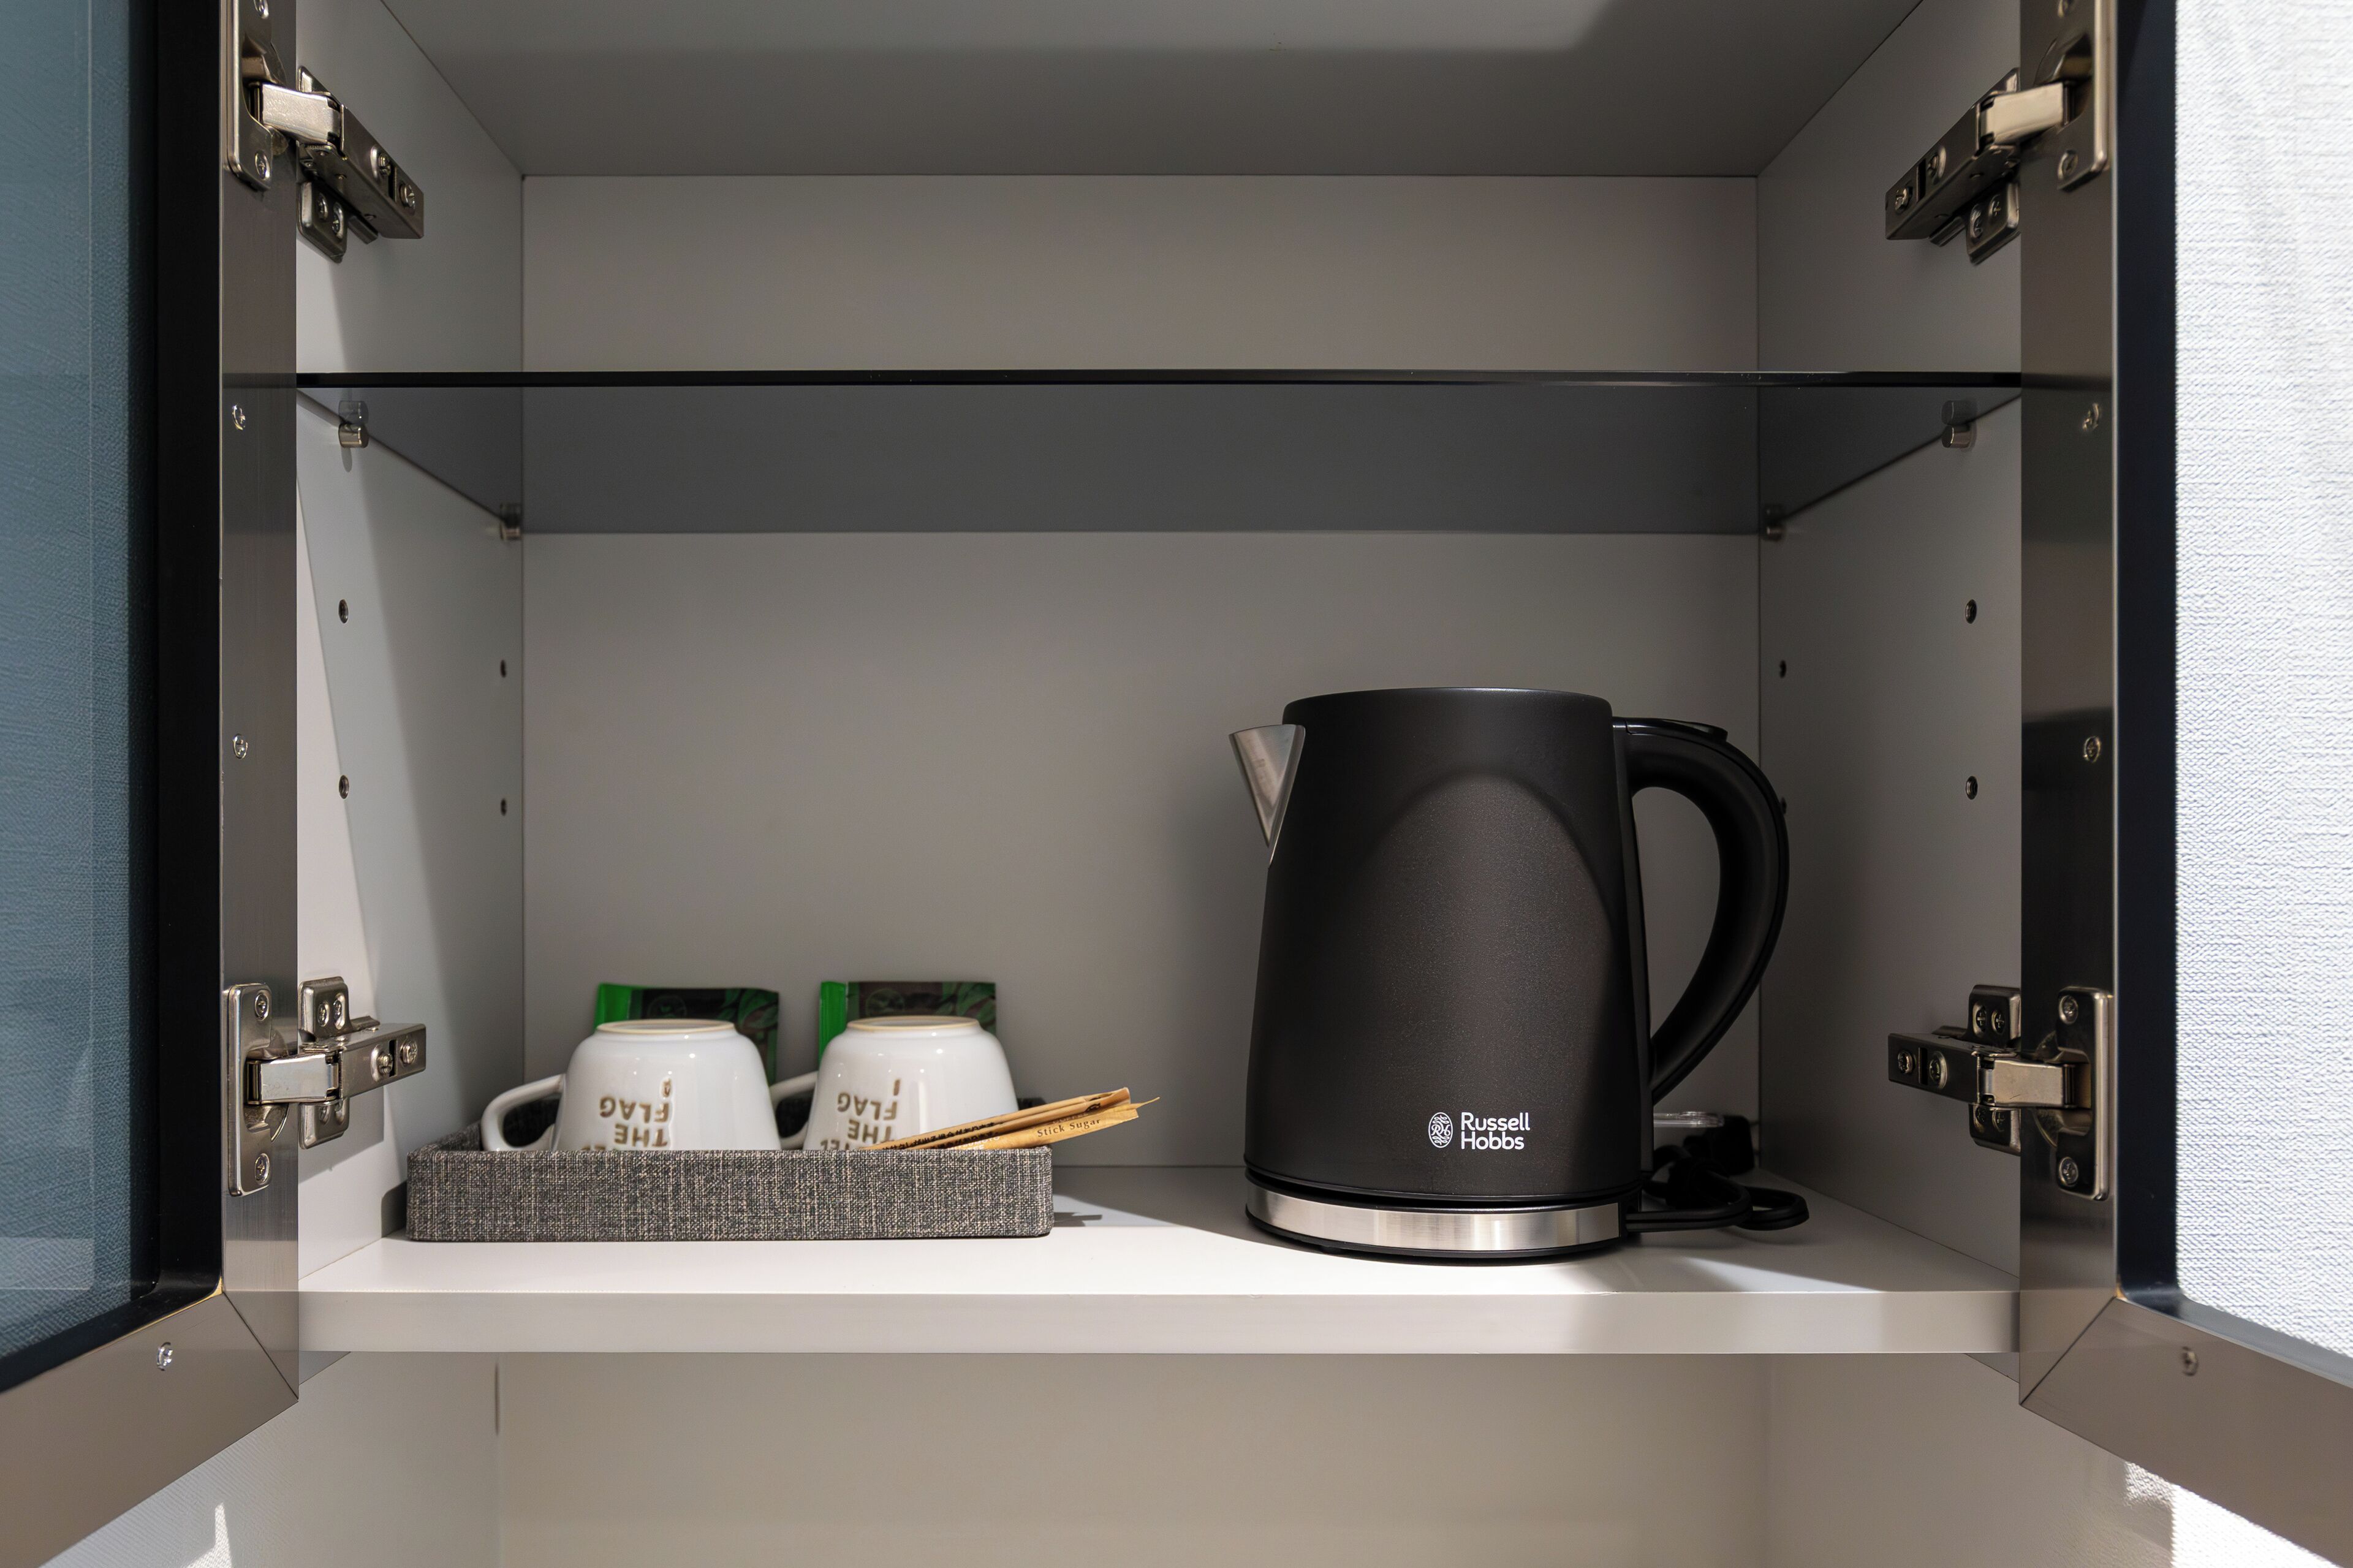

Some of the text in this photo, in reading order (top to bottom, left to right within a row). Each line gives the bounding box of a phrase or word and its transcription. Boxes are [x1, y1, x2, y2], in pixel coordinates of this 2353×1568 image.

[600, 1096, 669, 1124] FLAG
[837, 1092, 898, 1121] FLAG
[847, 1119, 895, 1144] THE
[1037, 1119, 1101, 1137] Stick Sugar
[1461, 1112, 1531, 1131] Russell
[614, 1123, 668, 1148] THE
[1461, 1131, 1525, 1150] Hobbs
